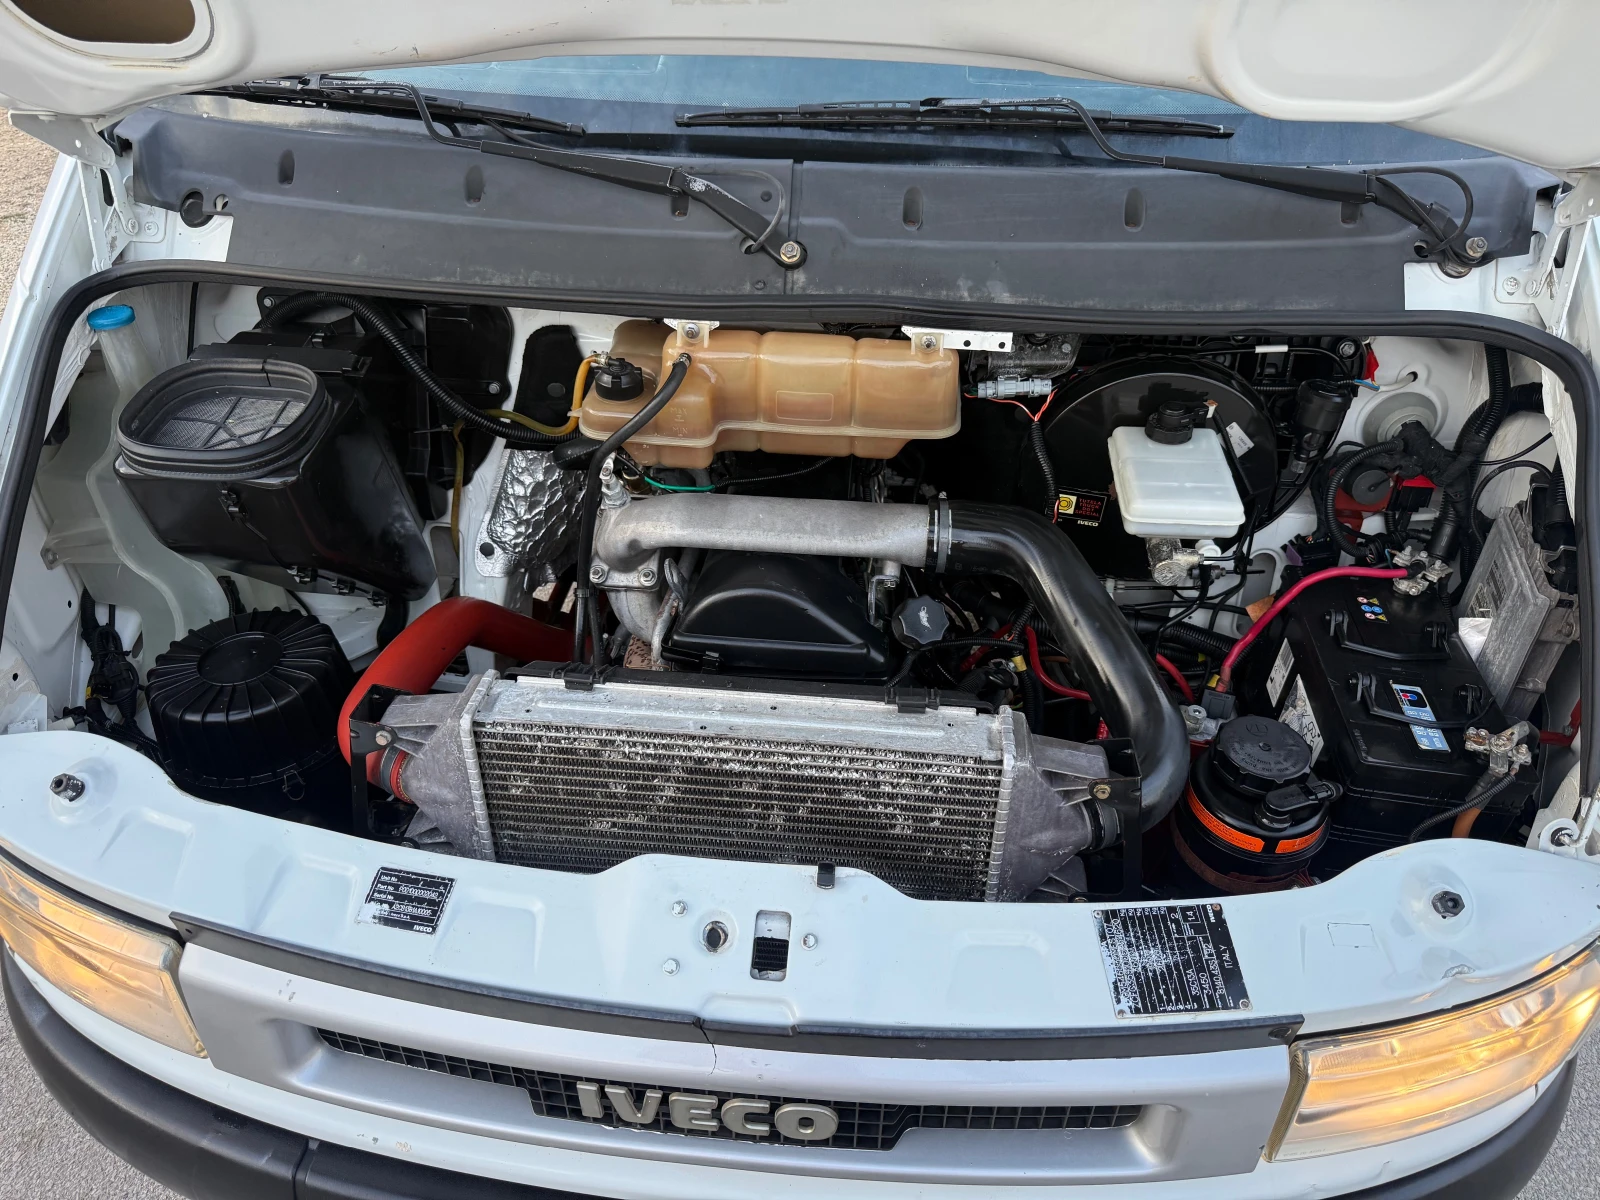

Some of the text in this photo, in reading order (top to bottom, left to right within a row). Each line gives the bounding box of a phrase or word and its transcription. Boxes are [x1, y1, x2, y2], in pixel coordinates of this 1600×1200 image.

[1206, 904, 1215, 922] IVECO
[1218, 944, 1233, 968] ITALY
[1185, 968, 1200, 995] 35C13A
[1198, 972, 1212, 994] 3450
[576, 1081, 839, 1140] IVECO
